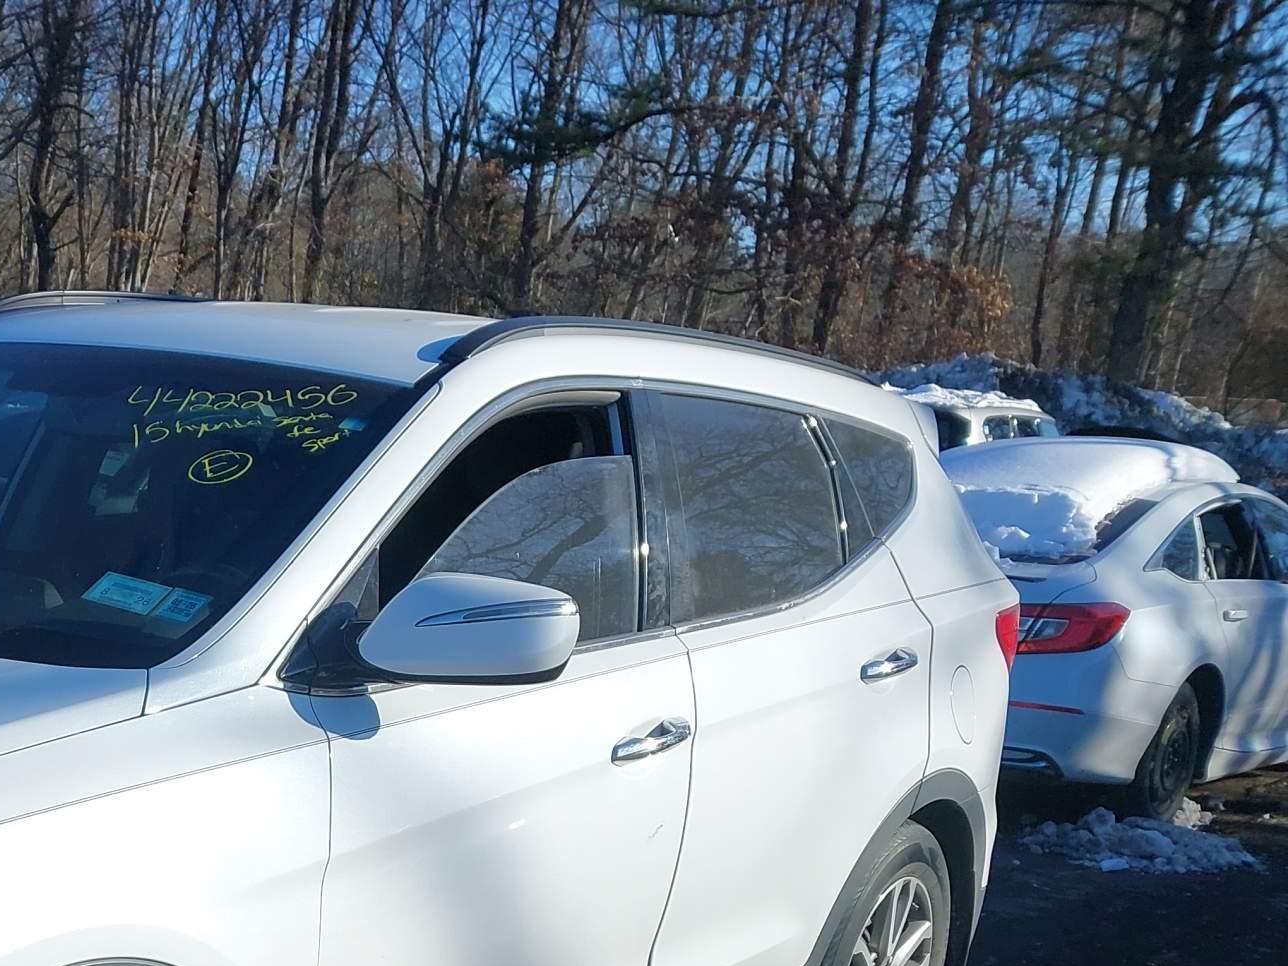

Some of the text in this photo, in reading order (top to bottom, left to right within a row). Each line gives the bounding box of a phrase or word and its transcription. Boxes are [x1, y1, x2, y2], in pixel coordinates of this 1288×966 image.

[127, 384, 358, 416] 44222456
[133, 421, 170, 449] 15
[201, 453, 239, 478] E
